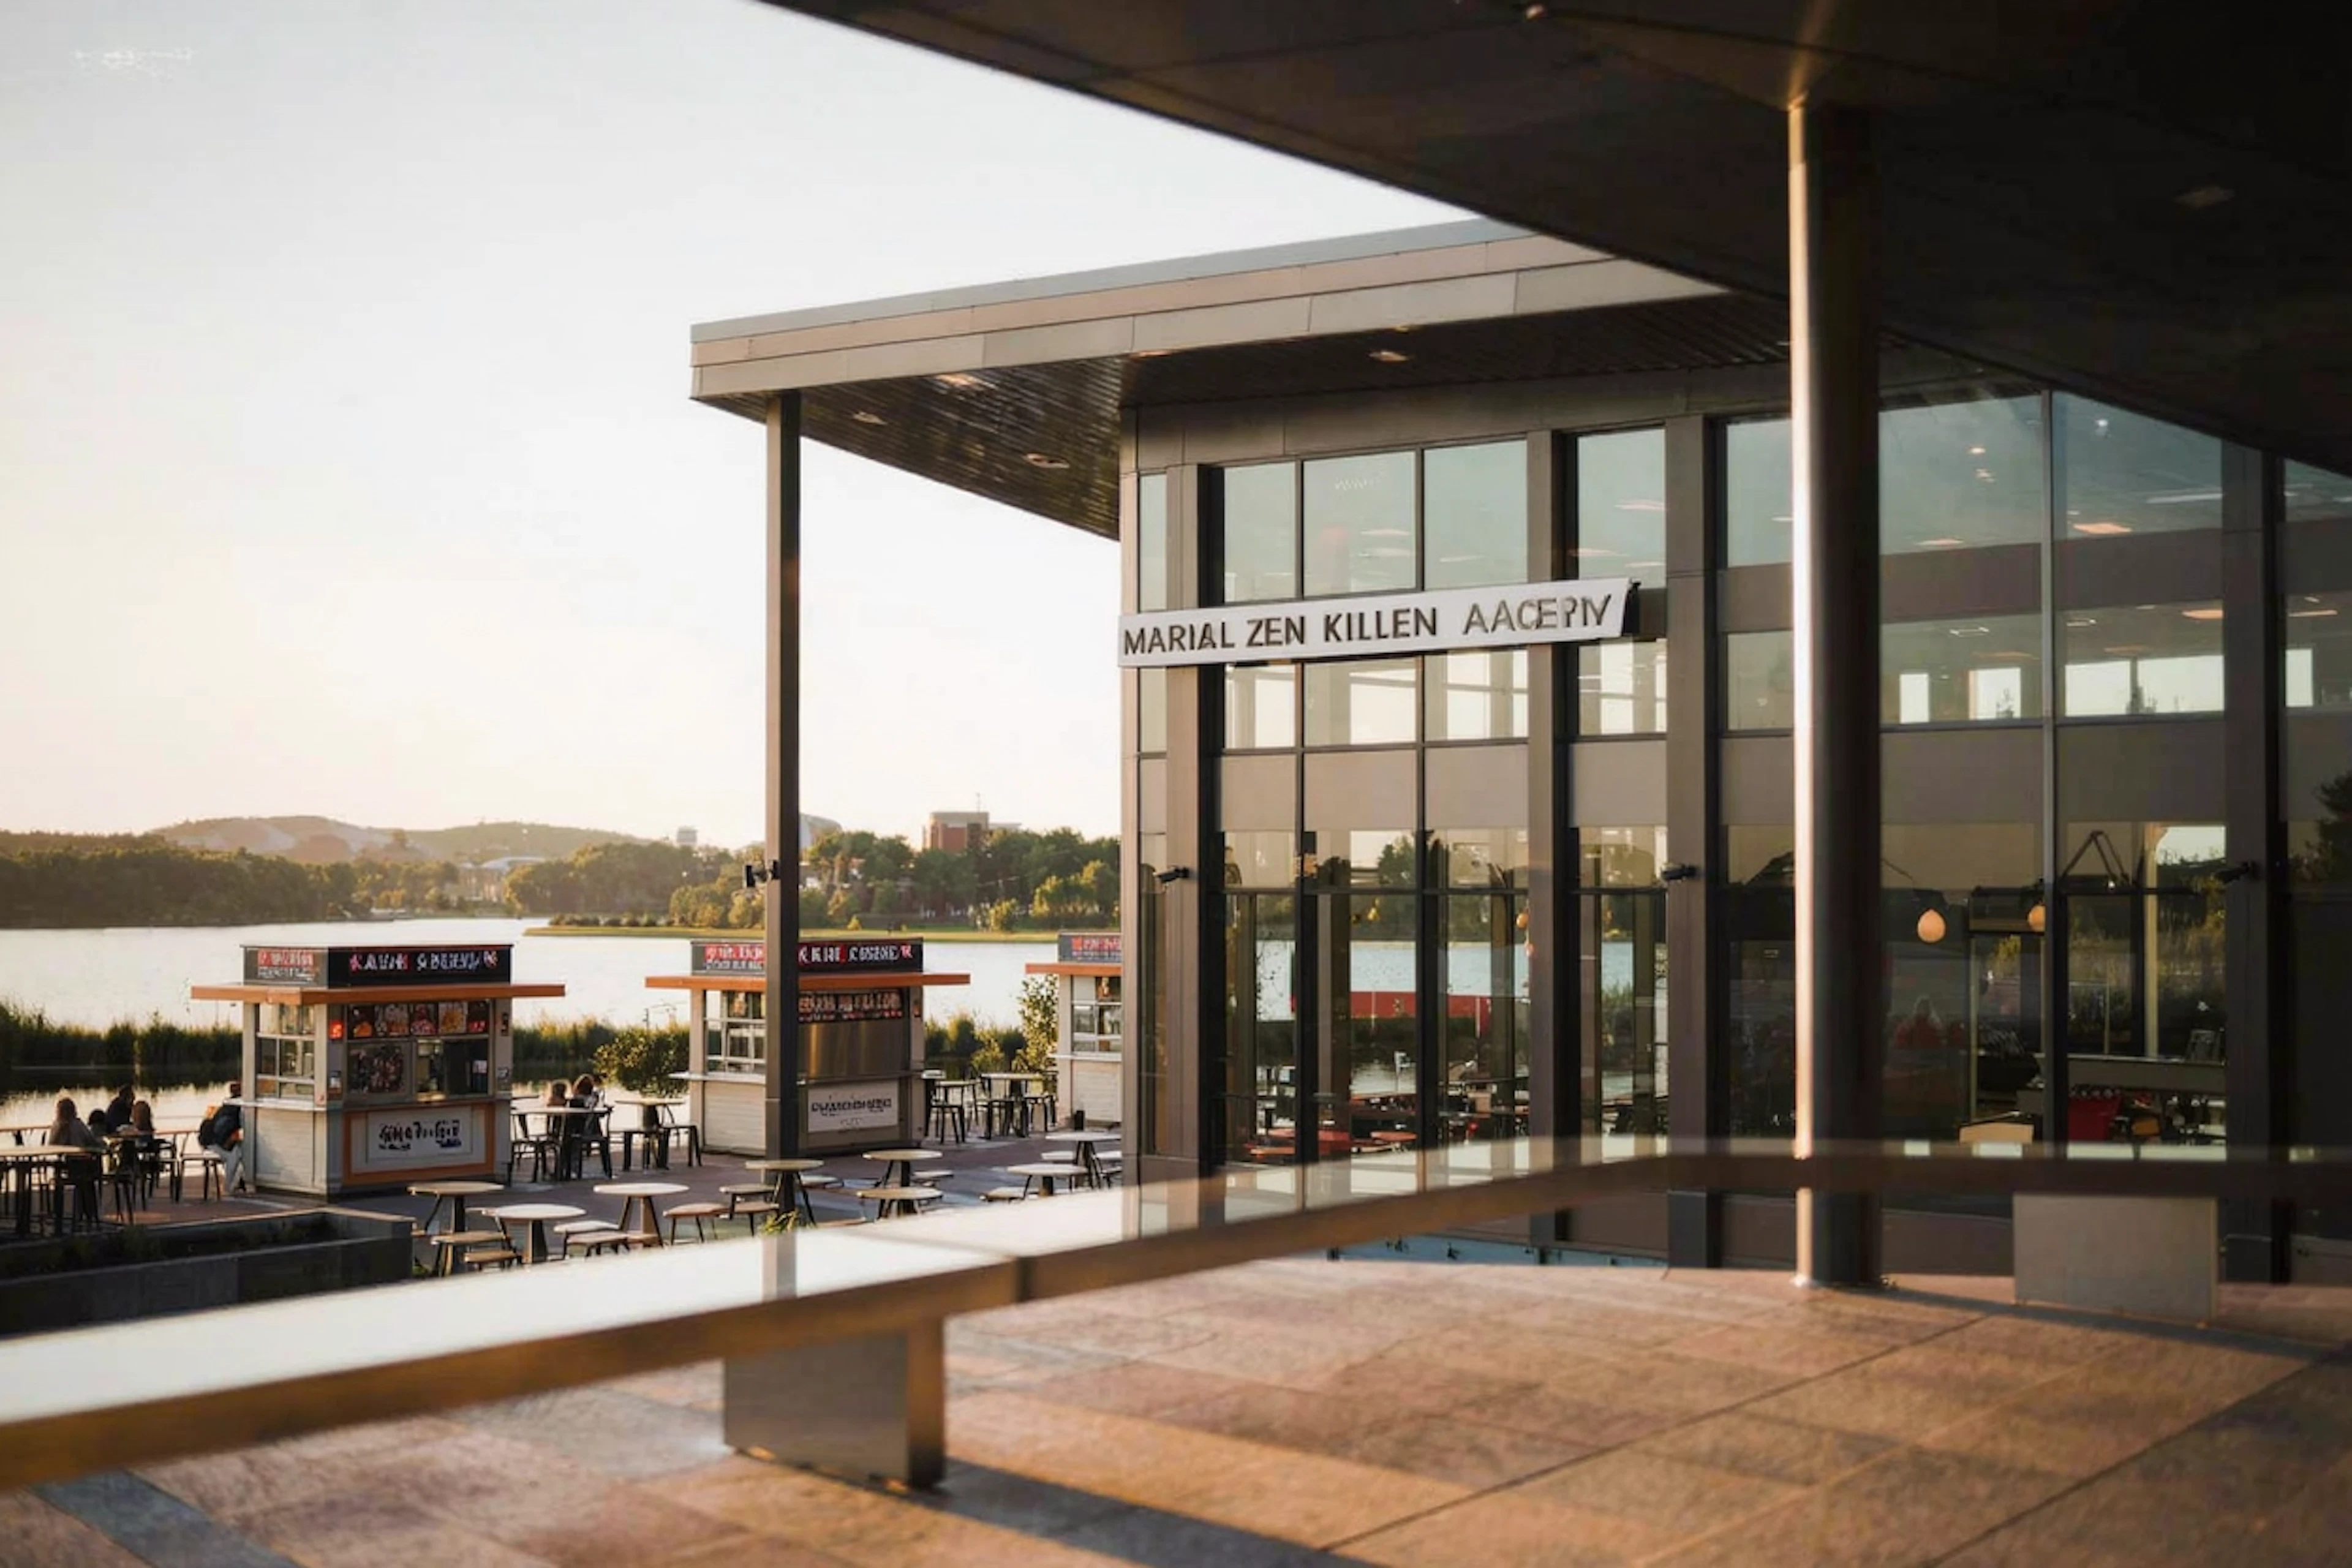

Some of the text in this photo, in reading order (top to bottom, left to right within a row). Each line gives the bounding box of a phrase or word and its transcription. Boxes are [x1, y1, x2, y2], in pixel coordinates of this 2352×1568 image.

[1124, 621, 1235, 655] MARIAL
[1246, 616, 1306, 647] ZEN
[1324, 607, 1436, 643] KILLEN
